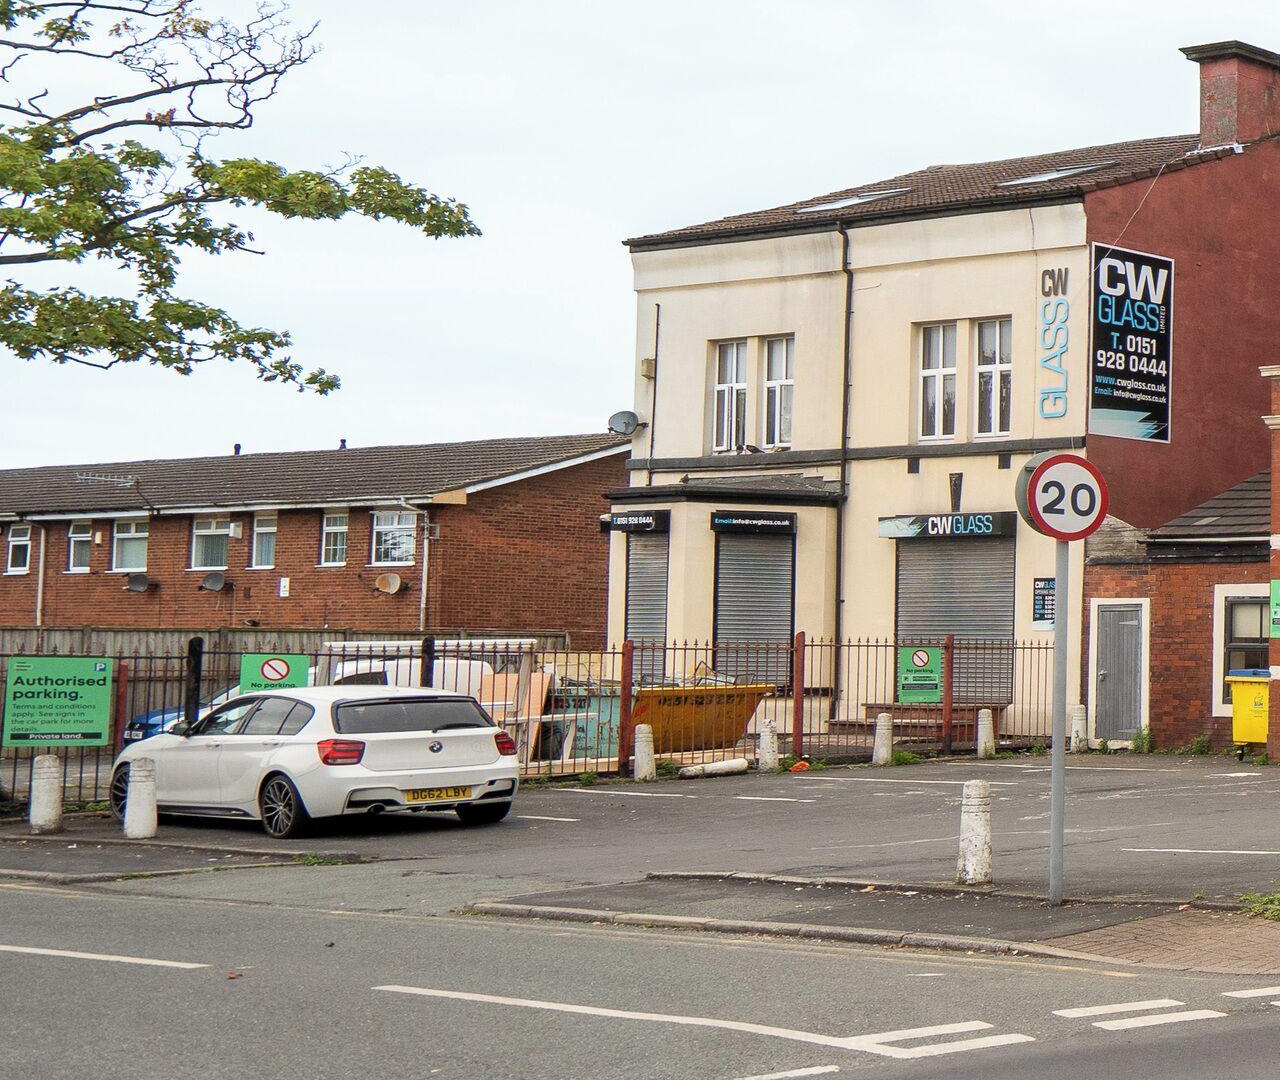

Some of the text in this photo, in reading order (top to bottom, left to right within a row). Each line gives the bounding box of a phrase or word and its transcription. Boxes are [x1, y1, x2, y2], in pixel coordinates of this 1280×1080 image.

[1041, 267, 1069, 297] CW
[1099, 258, 1168, 304] CW
[1098, 295, 1159, 332] GLASS
[1111, 332, 1156, 356] T. 0151
[1039, 297, 1070, 419] GLASS
[1097, 350, 1167, 377] 928 0444
[1095, 375, 1167, 393] www.cwglass.co.uk
[1113, 388, 1167, 404] info@cwglass.co.uk
[1041, 480, 1096, 517] 20
[928, 515, 993, 535] CW GLASS
[13, 676, 107, 687] Authorised
[13, 689, 84, 701] parking.
[412, 787, 467, 800] DG62 LBY
